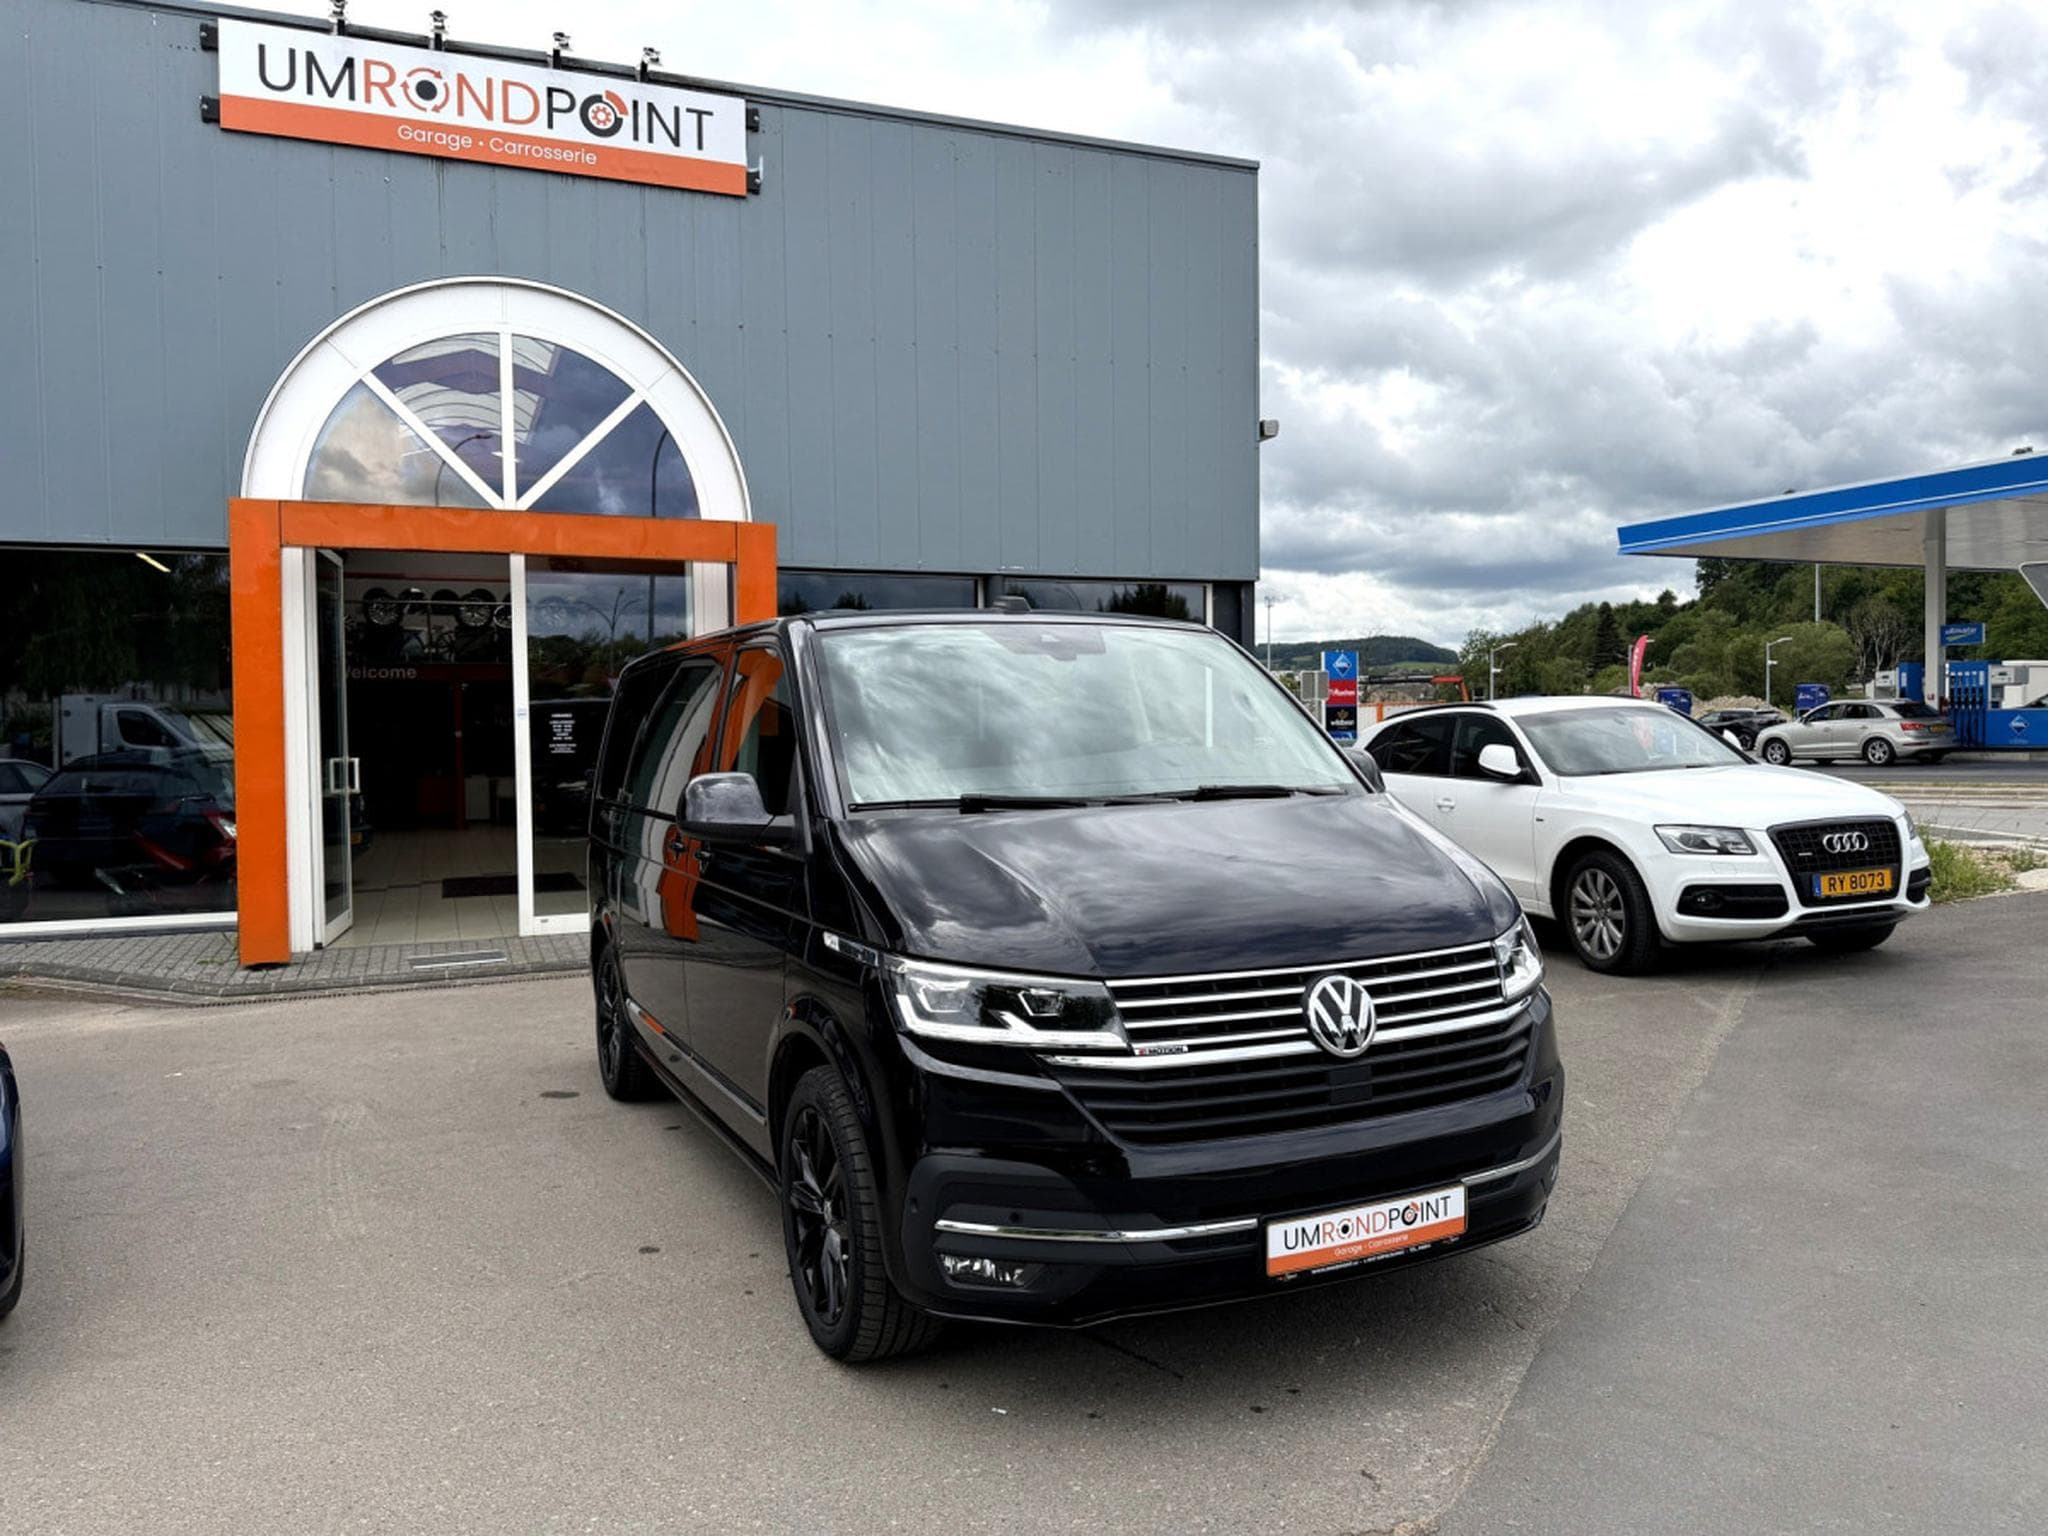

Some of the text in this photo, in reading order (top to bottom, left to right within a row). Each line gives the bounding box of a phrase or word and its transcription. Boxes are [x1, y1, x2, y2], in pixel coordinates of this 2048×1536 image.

[258, 43, 714, 151] UMRONDPOINT
[397, 125, 598, 166] Garage Carrosserie
[1828, 872, 1885, 892] RY 8073
[1284, 1195, 1451, 1250] UMRONDPOINT
